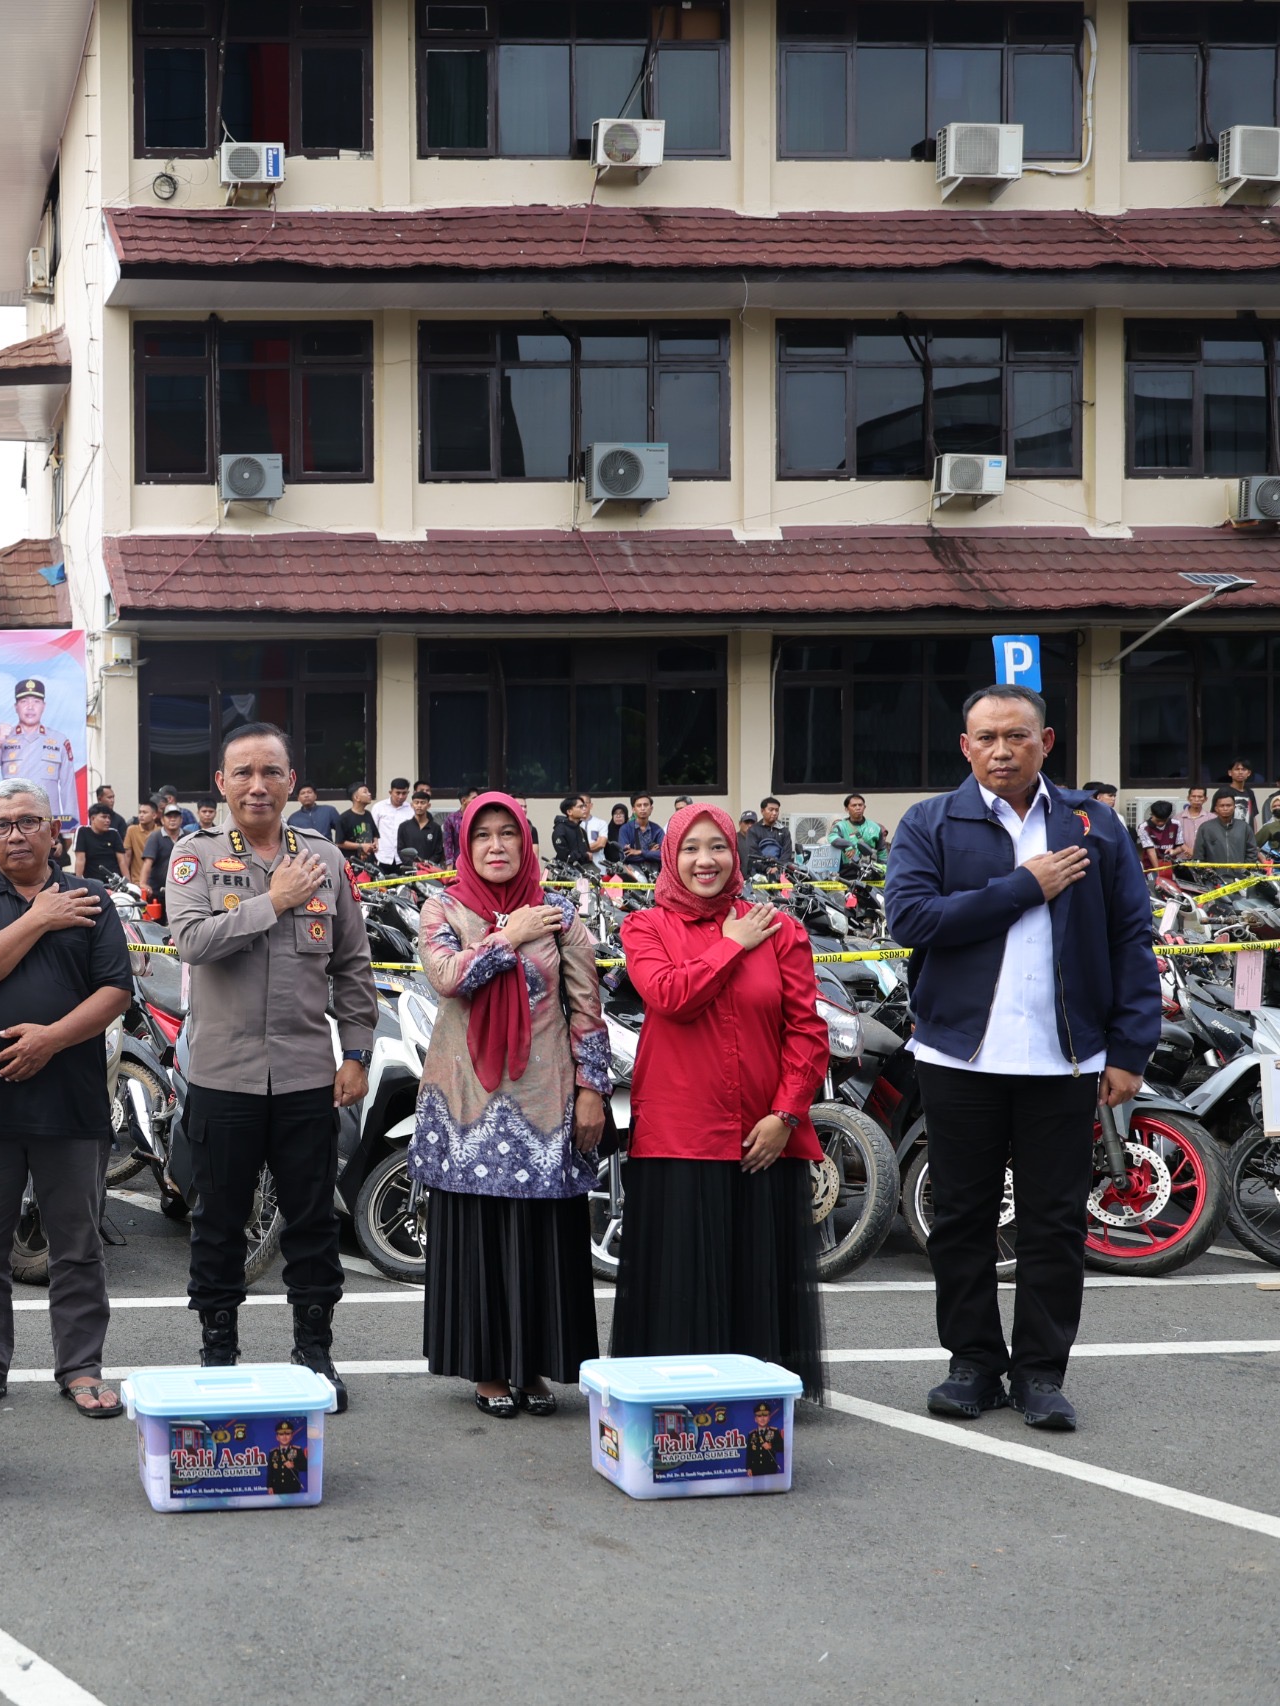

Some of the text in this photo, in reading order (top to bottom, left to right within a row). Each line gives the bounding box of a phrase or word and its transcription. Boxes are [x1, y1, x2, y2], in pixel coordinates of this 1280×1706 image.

[1003, 641, 1033, 685] P
[212, 874, 250, 887] FERI
[127, 945, 165, 953] MELINTAS
[1178, 946, 1204, 954] POLICE
[1241, 943, 1266, 951] CROSS
[816, 954, 843, 963] POLICE
[879, 950, 905, 960] CROSS
[654, 1429, 747, 1454] Tali Asih
[172, 1446, 268, 1469] Tali Asih
[661, 1450, 740, 1463] KAPOLDA SUMSEL
[179, 1467, 261, 1478] KAPOLDA SUMSEL
